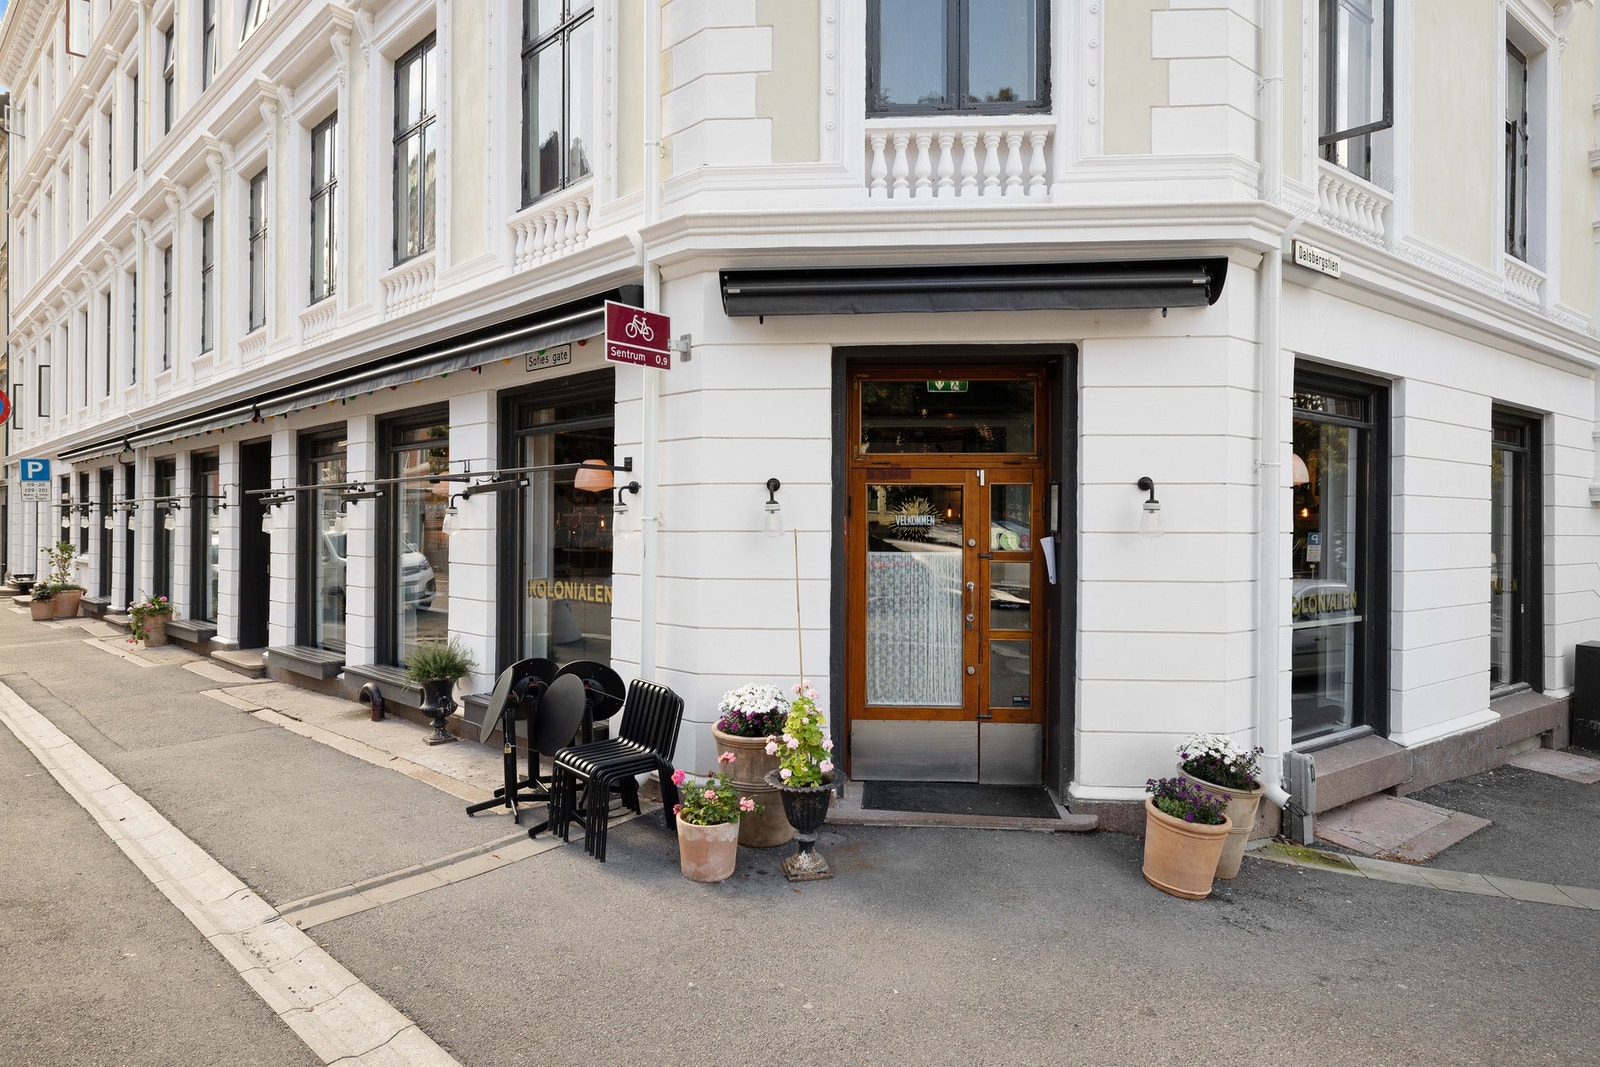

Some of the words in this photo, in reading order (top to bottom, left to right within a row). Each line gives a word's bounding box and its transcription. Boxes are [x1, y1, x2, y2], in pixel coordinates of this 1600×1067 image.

[1298, 245, 1339, 272] Dalsbergstien
[528, 354, 549, 367] Sofies
[553, 350, 568, 365] gate
[611, 346, 646, 362] Sentrum
[655, 354, 668, 366] 0.9
[27, 461, 43, 479] P
[895, 515, 935, 526] VELKOMMEN
[528, 578, 612, 603] KOLONIALEN
[1292, 591, 1357, 615] OLONIALEN
